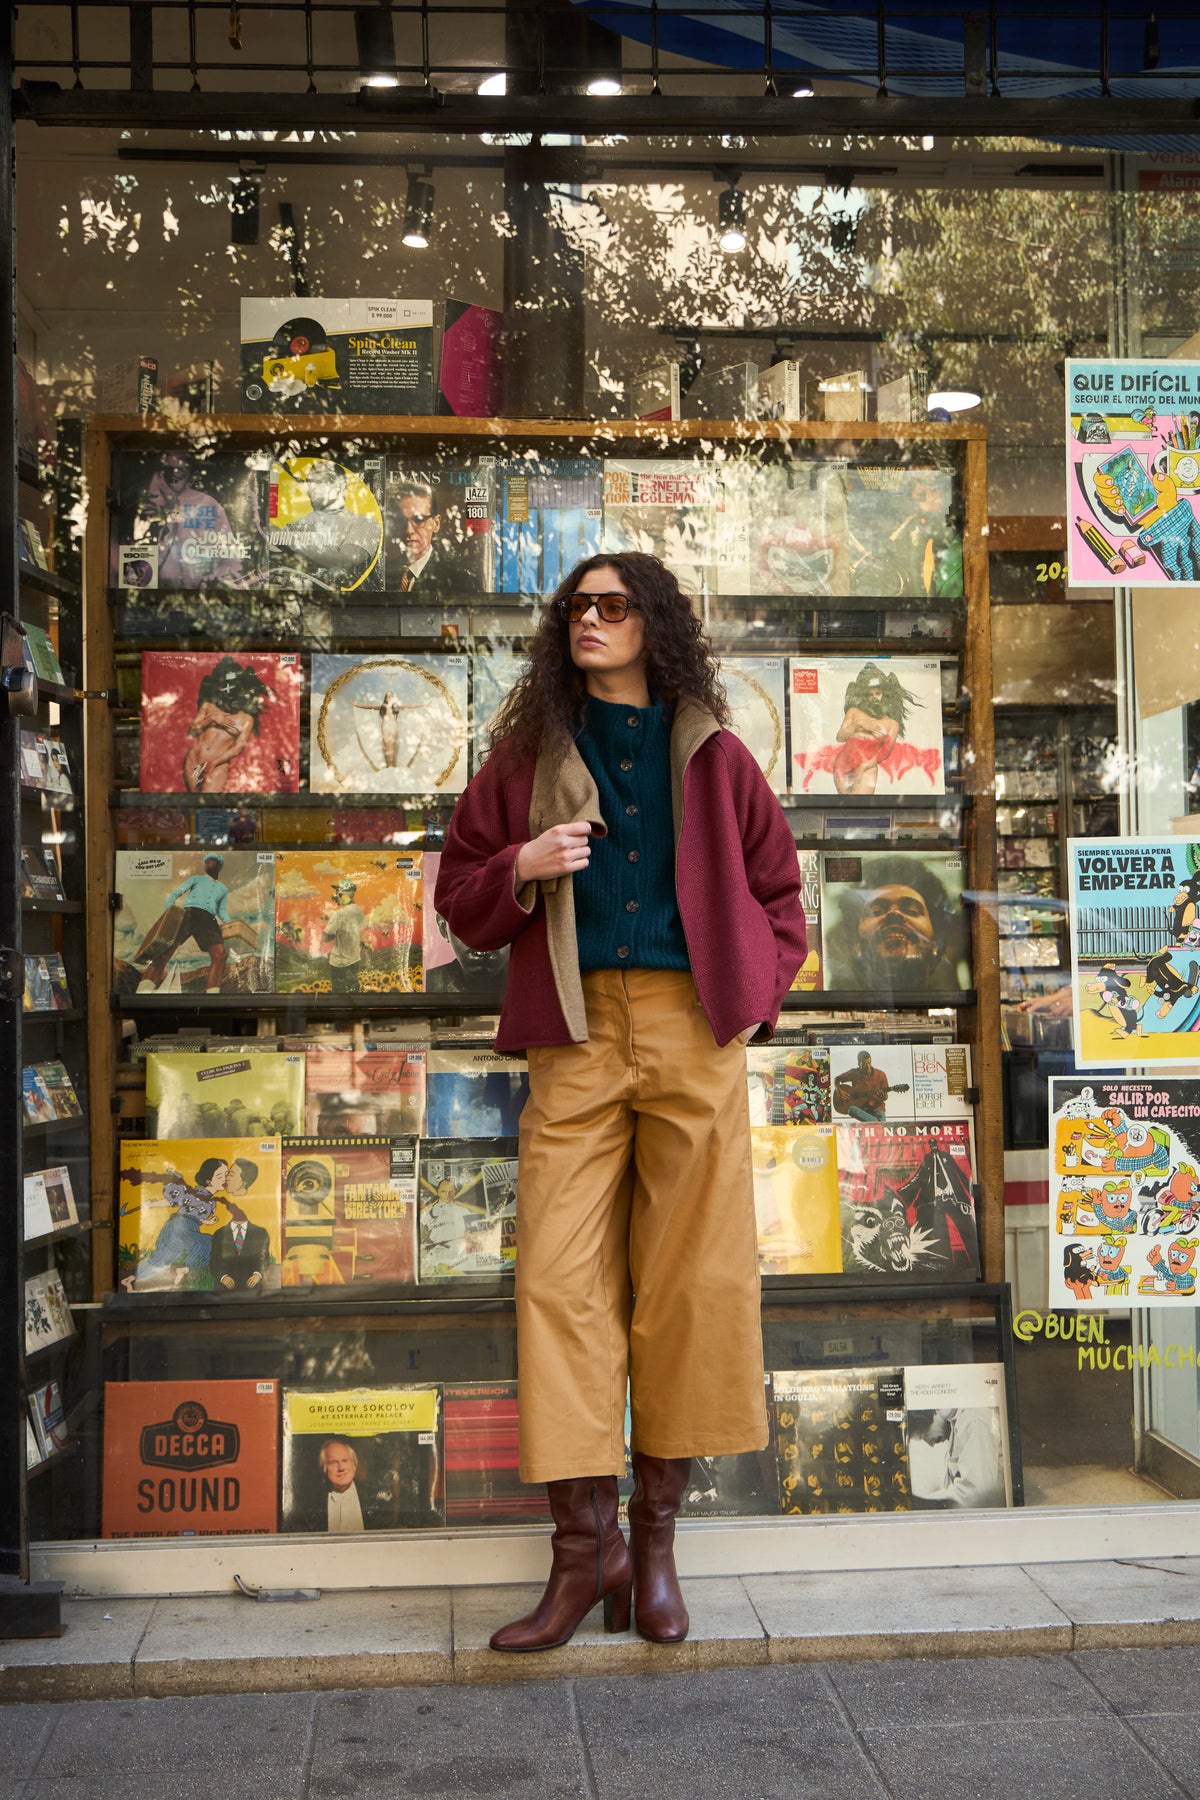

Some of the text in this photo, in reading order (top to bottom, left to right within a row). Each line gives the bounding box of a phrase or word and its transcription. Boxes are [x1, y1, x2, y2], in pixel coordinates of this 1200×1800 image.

[348, 336, 417, 356] Spin-Clean
[1073, 374, 1114, 391] QUE
[1121, 370, 1190, 392] DIFÍCIL
[1074, 395, 1110, 404] SEGUIR
[1112, 395, 1123, 404] EL
[1125, 395, 1156, 405] RITMO
[1158, 396, 1176, 404] DEL
[388, 470, 441, 484] EVANS
[609, 483, 630, 493] THE
[467, 507, 482, 519] 180
[269, 532, 294, 546] JOHN
[1078, 856, 1174, 874] VOLVER A
[1079, 873, 1176, 891] EMPEZAR
[914, 1051, 936, 1062] big
[916, 1092, 944, 1101] JORGE
[1108, 1092, 1170, 1106] SALIR POR
[1134, 1105, 1200, 1118] UN CAFECITO
[884, 1126, 907, 1137] NO
[915, 1125, 965, 1136] MORE
[1013, 1310, 1110, 1344] @BUEN.
[828, 1343, 848, 1352] SALSA
[1078, 1344, 1200, 1371] MUCHACH
[821, 1383, 875, 1392] VARIATIONS
[309, 1405, 357, 1413] GRIGORY
[155, 1433, 225, 1457] DECCA
[137, 1477, 240, 1513] SOUND
[226, 1528, 269, 1536] FIDELITY
